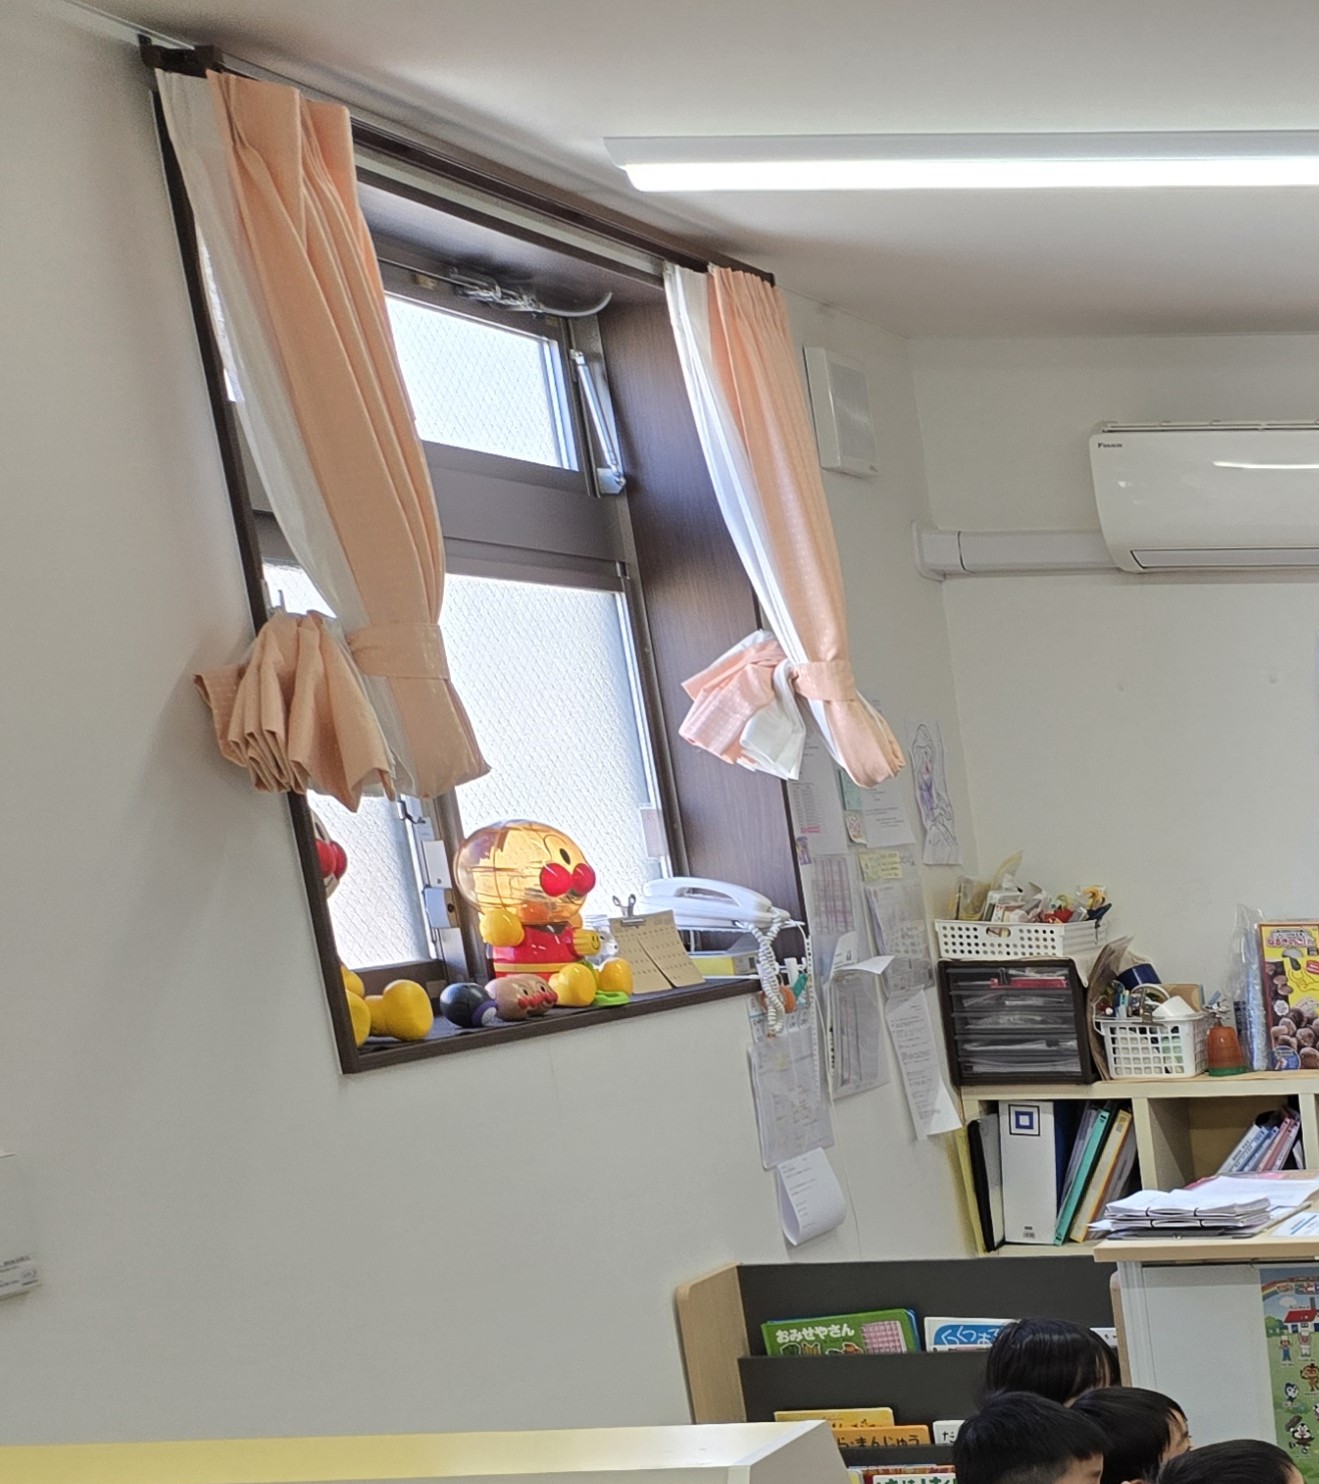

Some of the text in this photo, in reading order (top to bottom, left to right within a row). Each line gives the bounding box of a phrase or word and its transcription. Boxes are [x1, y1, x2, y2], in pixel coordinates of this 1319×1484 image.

[776, 1323, 855, 1343] おみせやさん
